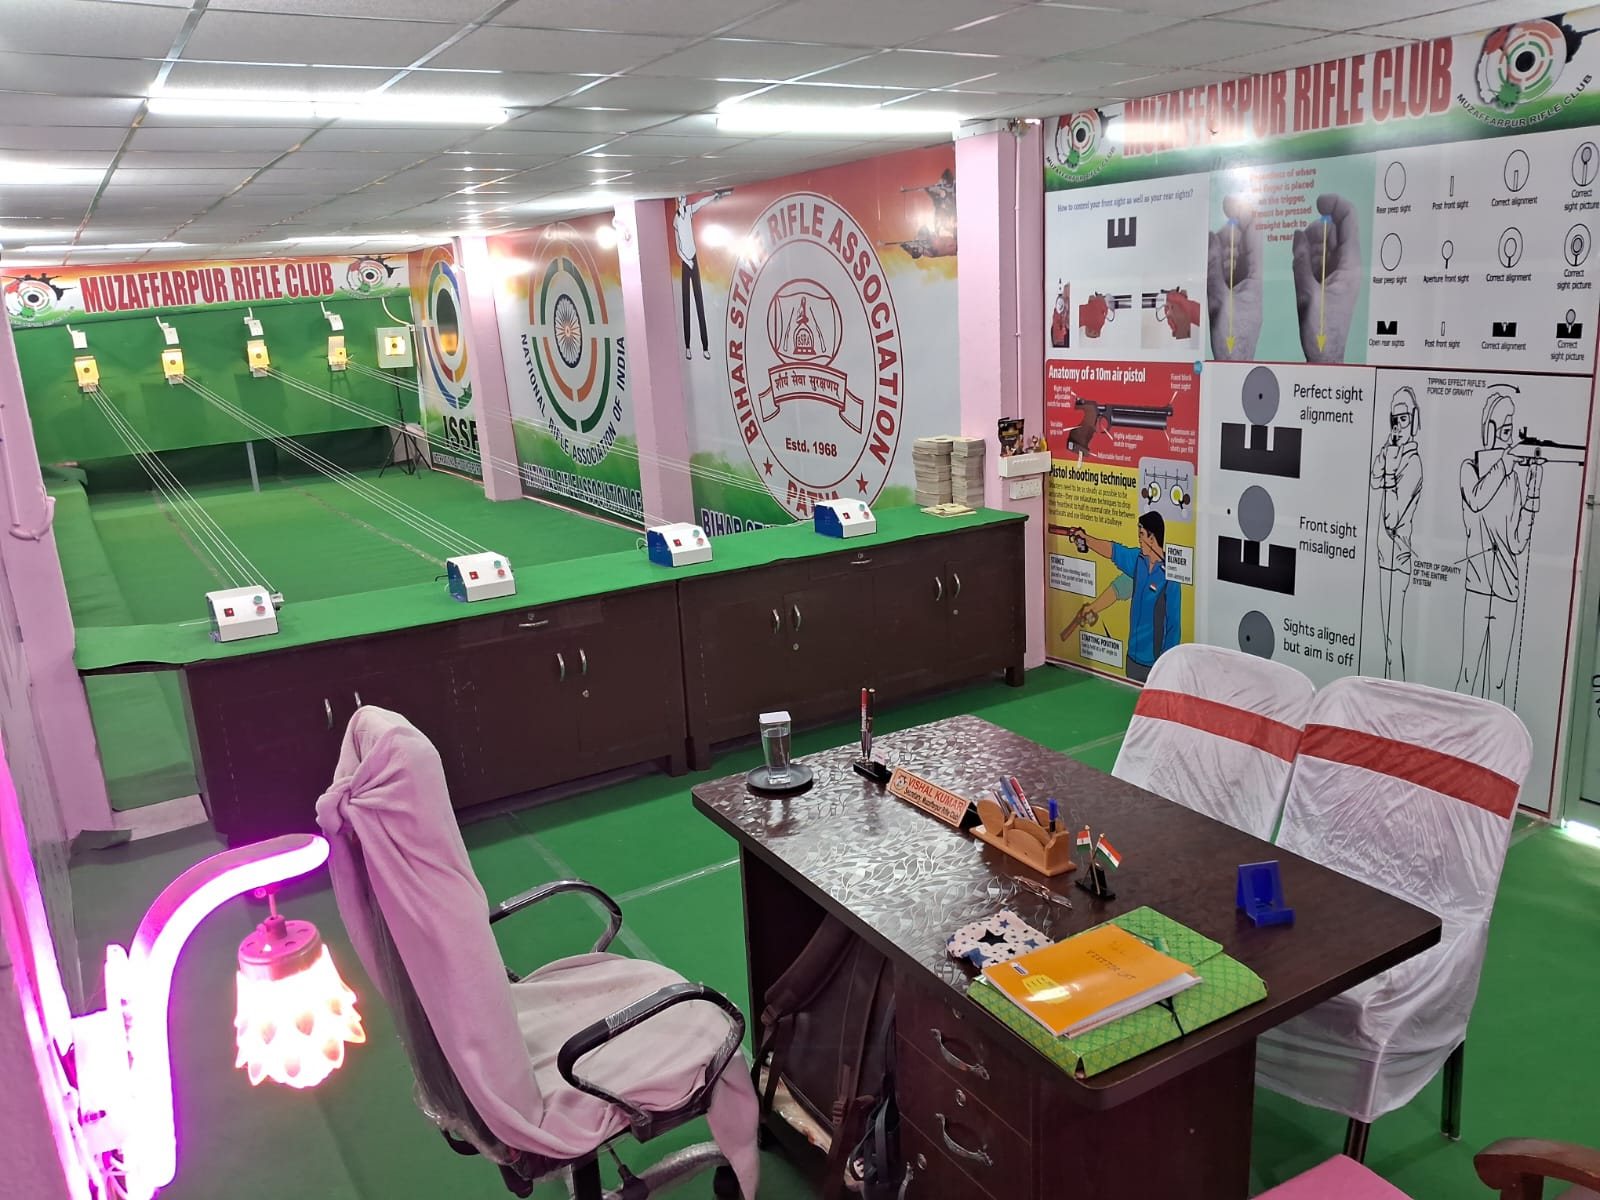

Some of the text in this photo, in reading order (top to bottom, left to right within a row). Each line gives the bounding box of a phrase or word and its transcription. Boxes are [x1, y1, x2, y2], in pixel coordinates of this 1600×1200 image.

[1123, 36, 1453, 157] MUZAFFARPUR RIFLE CLUB
[1456, 74, 1593, 128] MUZAFFARPUR RIFLE CLUB
[1295, 167, 1316, 176] where
[1291, 178, 1315, 192] placed
[1571, 189, 1593, 198] Correct
[1432, 200, 1469, 211] Post front sight
[1491, 195, 1538, 208] Correct alignment
[1564, 200, 1600, 212] sight picture
[1285, 206, 1312, 218] pressed
[1400, 204, 1412, 214] sight
[1282, 219, 1298, 229] back
[1299, 220, 1308, 228] to
[1395, 275, 1407, 285] sight
[1423, 273, 1470, 285] Aperture front sight
[1486, 272, 1532, 284] Correct alignment
[1563, 269, 1585, 278] Correct
[79, 267, 228, 313] MUZAFFARPUR
[231, 265, 283, 301] RIFLE
[285, 262, 335, 298] CLUB
[1556, 280, 1592, 291] sight picture
[729, 340, 762, 446] BIHAR
[767, 202, 825, 246] RIFLE
[828, 217, 899, 466] ASSOCIATION
[1424, 339, 1435, 348] Post
[1447, 339, 1460, 350] sight
[1481, 340, 1527, 352] Correct alignment
[1557, 340, 1578, 350] Correct
[1550, 351, 1585, 362] sight picture
[790, 369, 806, 387] सेवा
[1048, 364, 1146, 385] Anatomy of a 10m air pistol
[1427, 377, 1447, 386] TIPPING
[1447, 378, 1467, 387] EFFECT
[1293, 383, 1364, 404] Perfect sight
[1426, 386, 1474, 396] FORCE OF GRAVITY
[520, 333, 626, 464] NATIONAL RIFLE ASSOCIATION OF INDIA
[1299, 405, 1354, 424] alignment
[785, 437, 838, 457] Estd. 1968
[1049, 464, 1068, 479] Pistol
[1068, 466, 1099, 486] shooting
[1100, 471, 1137, 490] technique
[578, 475, 629, 514] ASSOCIATION
[1299, 516, 1357, 540] Front sight
[1299, 539, 1356, 560] misaligned
[1167, 555, 1187, 566] BLINDER
[1413, 560, 1462, 575] CENTER OF GRAVITY
[1413, 568, 1448, 582] OF THE ENTIRE
[1412, 577, 1433, 588] SYSTEM
[1283, 618, 1356, 647] Sights aligned
[1283, 638, 1356, 667] but aim is off
[908, 777, 965, 811] VISHAL KUMAR
